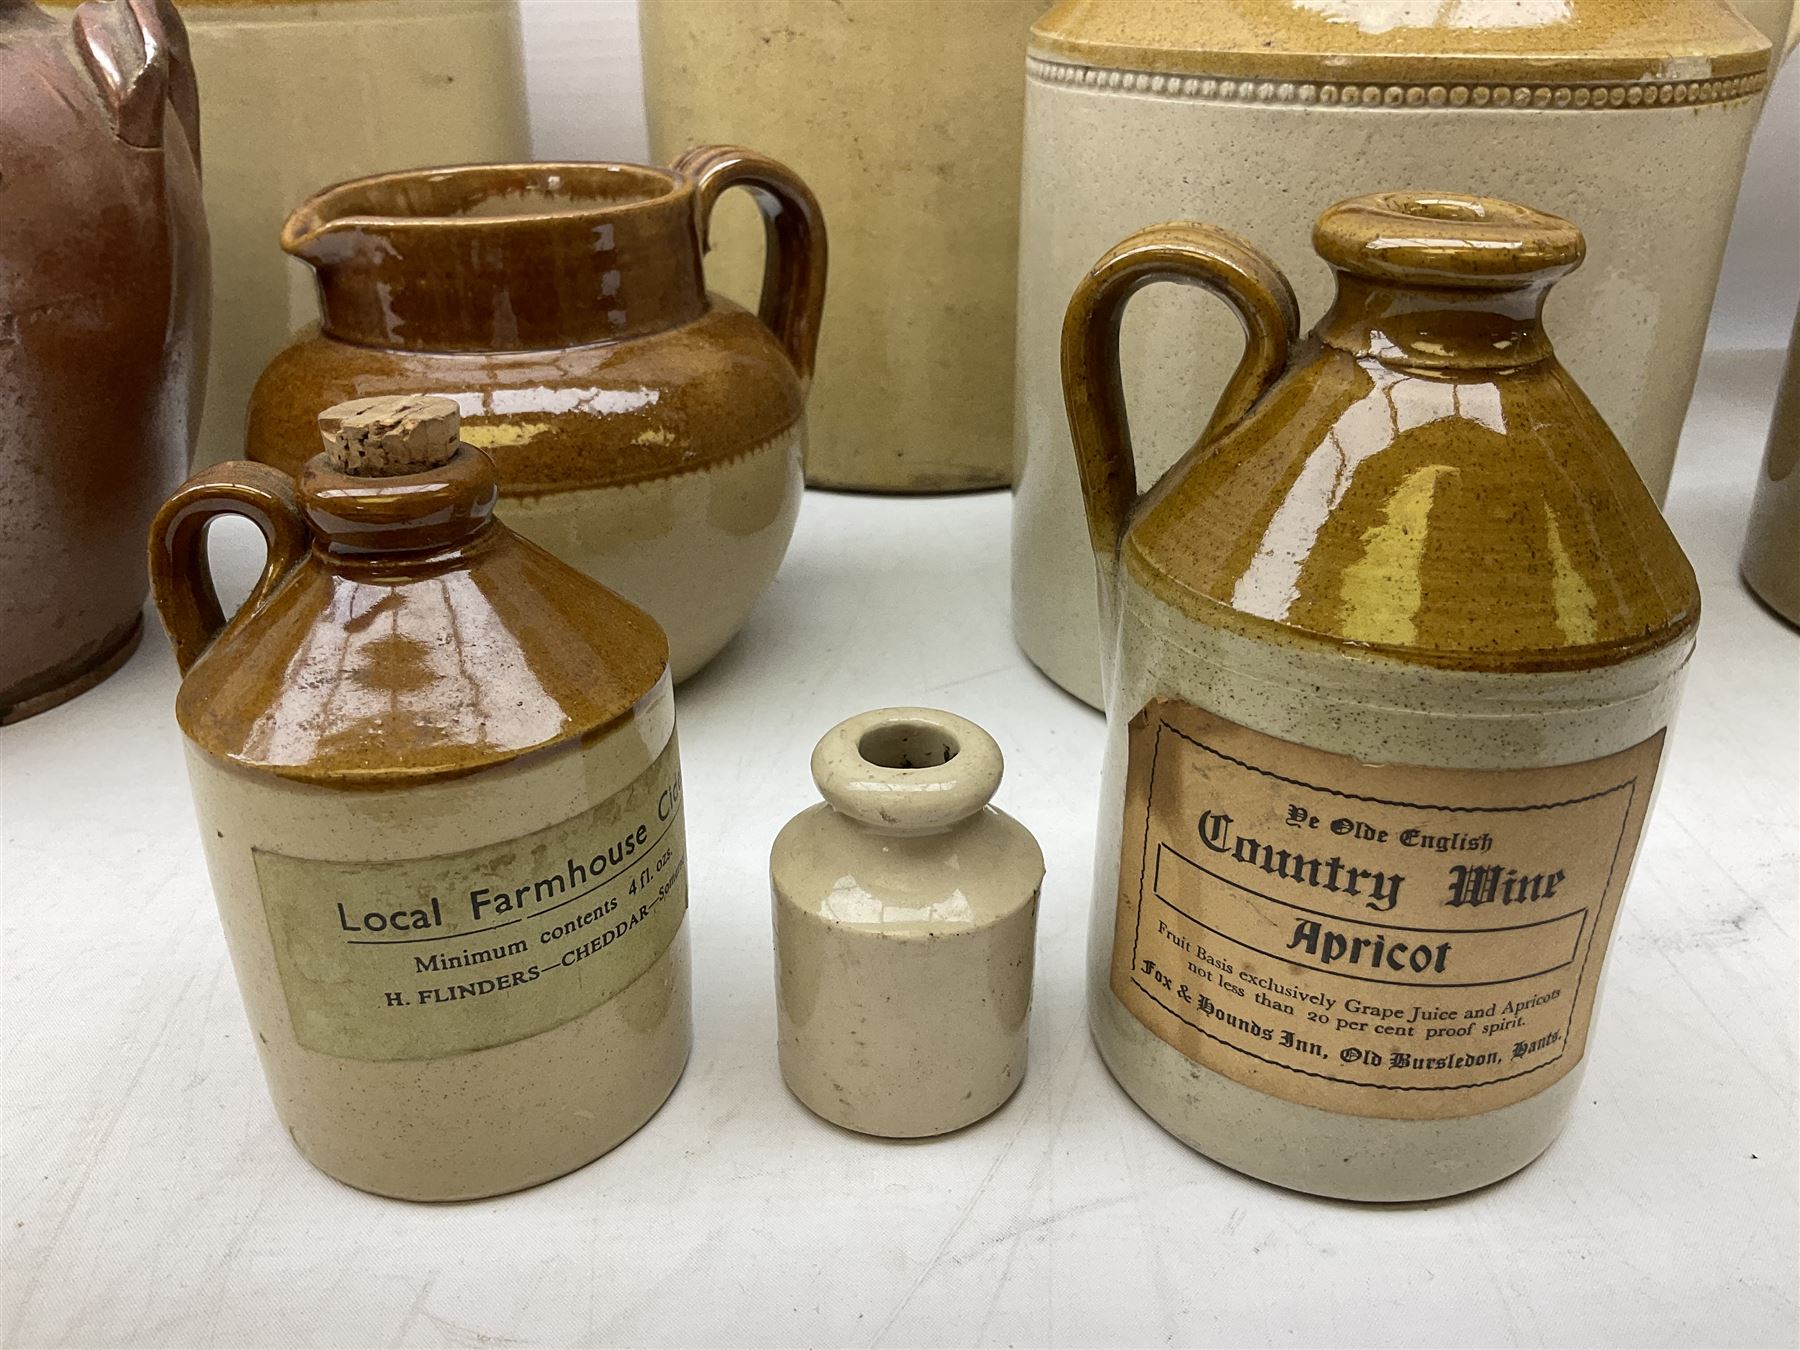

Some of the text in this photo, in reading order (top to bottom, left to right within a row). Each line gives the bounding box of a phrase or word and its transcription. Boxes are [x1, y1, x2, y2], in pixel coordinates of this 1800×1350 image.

[336, 896, 443, 932] Local
[469, 824, 648, 921] Farmhouse
[1197, 809, 1566, 912] Country Wine
[1284, 803, 1494, 855] Ye Olde English
[413, 939, 529, 973] Minimum
[540, 896, 618, 945] contents
[656, 847, 673, 873] ozs.
[1285, 917, 1452, 974] Apricot
[384, 991, 411, 1007] H.
[1140, 959, 1562, 1071] Fox & Hounds Inn, Old Bursledon, Hants.
[1157, 919, 1561, 1024] Fruit Basis exclusively Grape Juice and Apricots
[1187, 961, 1526, 1041] not less than 20 per cent proof spirit.
